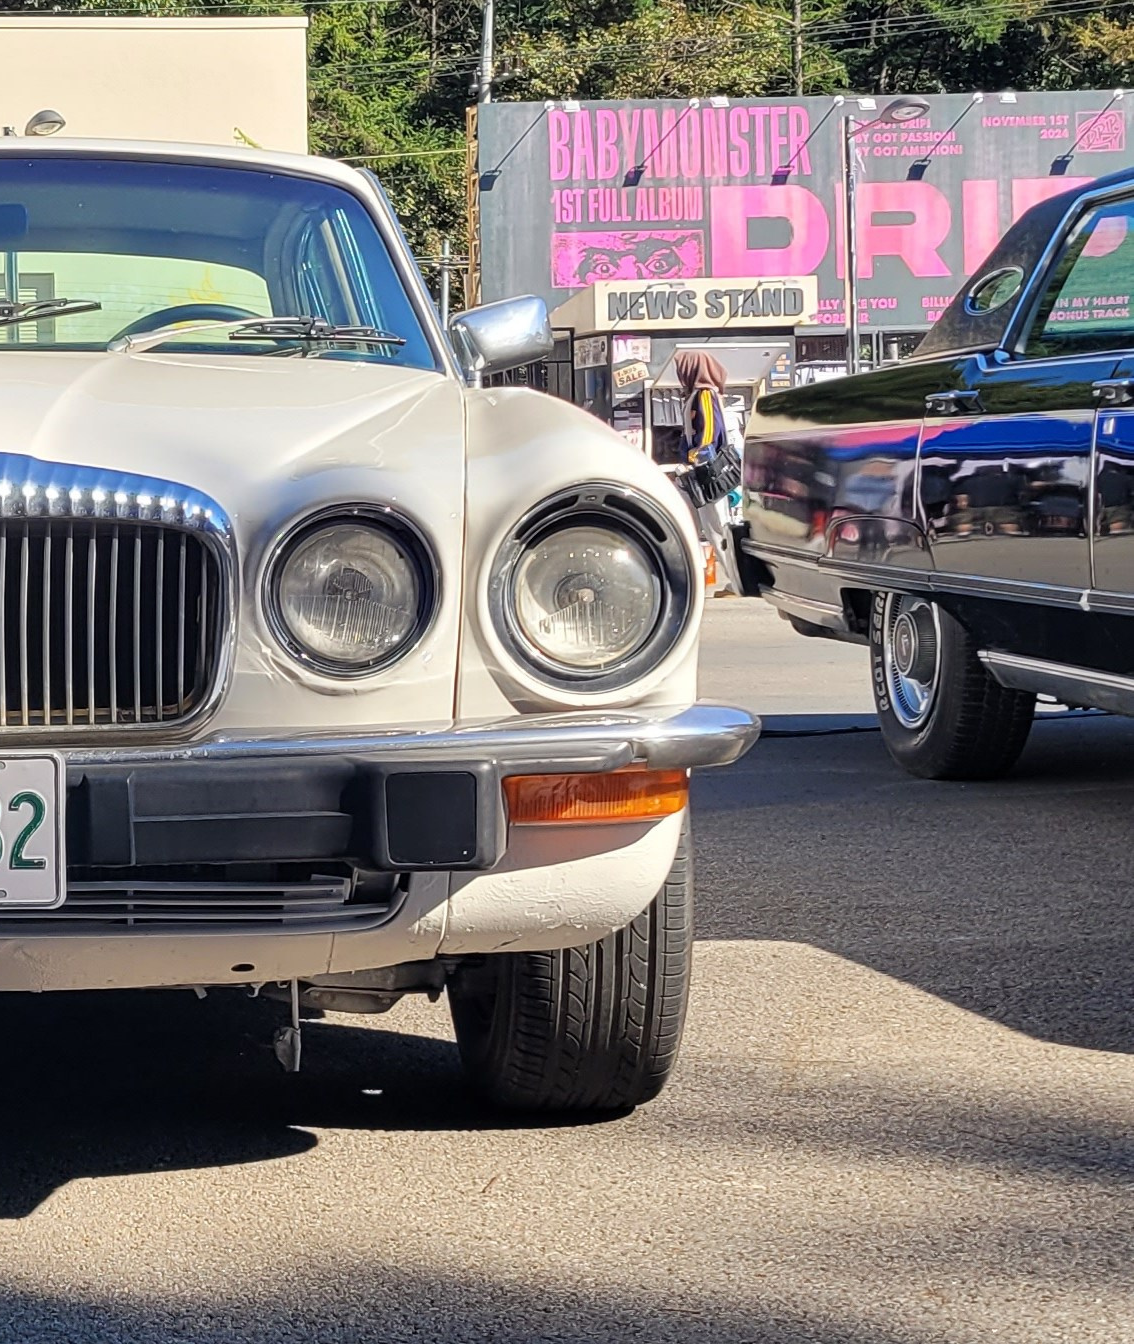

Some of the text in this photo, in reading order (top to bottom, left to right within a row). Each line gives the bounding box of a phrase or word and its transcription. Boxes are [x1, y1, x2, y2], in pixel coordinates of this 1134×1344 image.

[982, 115, 1069, 127] NOVEMBER 1ST
[873, 133, 897, 143] GOT
[900, 131, 956, 143] PASSION!
[1040, 128, 1069, 139] 2024
[548, 106, 812, 181] BABYMONSTER
[873, 147, 898, 157] GOT
[901, 144, 963, 157] AMBITION!
[551, 187, 703, 223] 1ST FULL ALBUM
[607, 288, 804, 321] NEWS STAND
[870, 298, 898, 309] YOU
[1072, 298, 1090, 307] MY
[1094, 296, 1129, 306] HEART
[1092, 308, 1130, 318] TRACK
